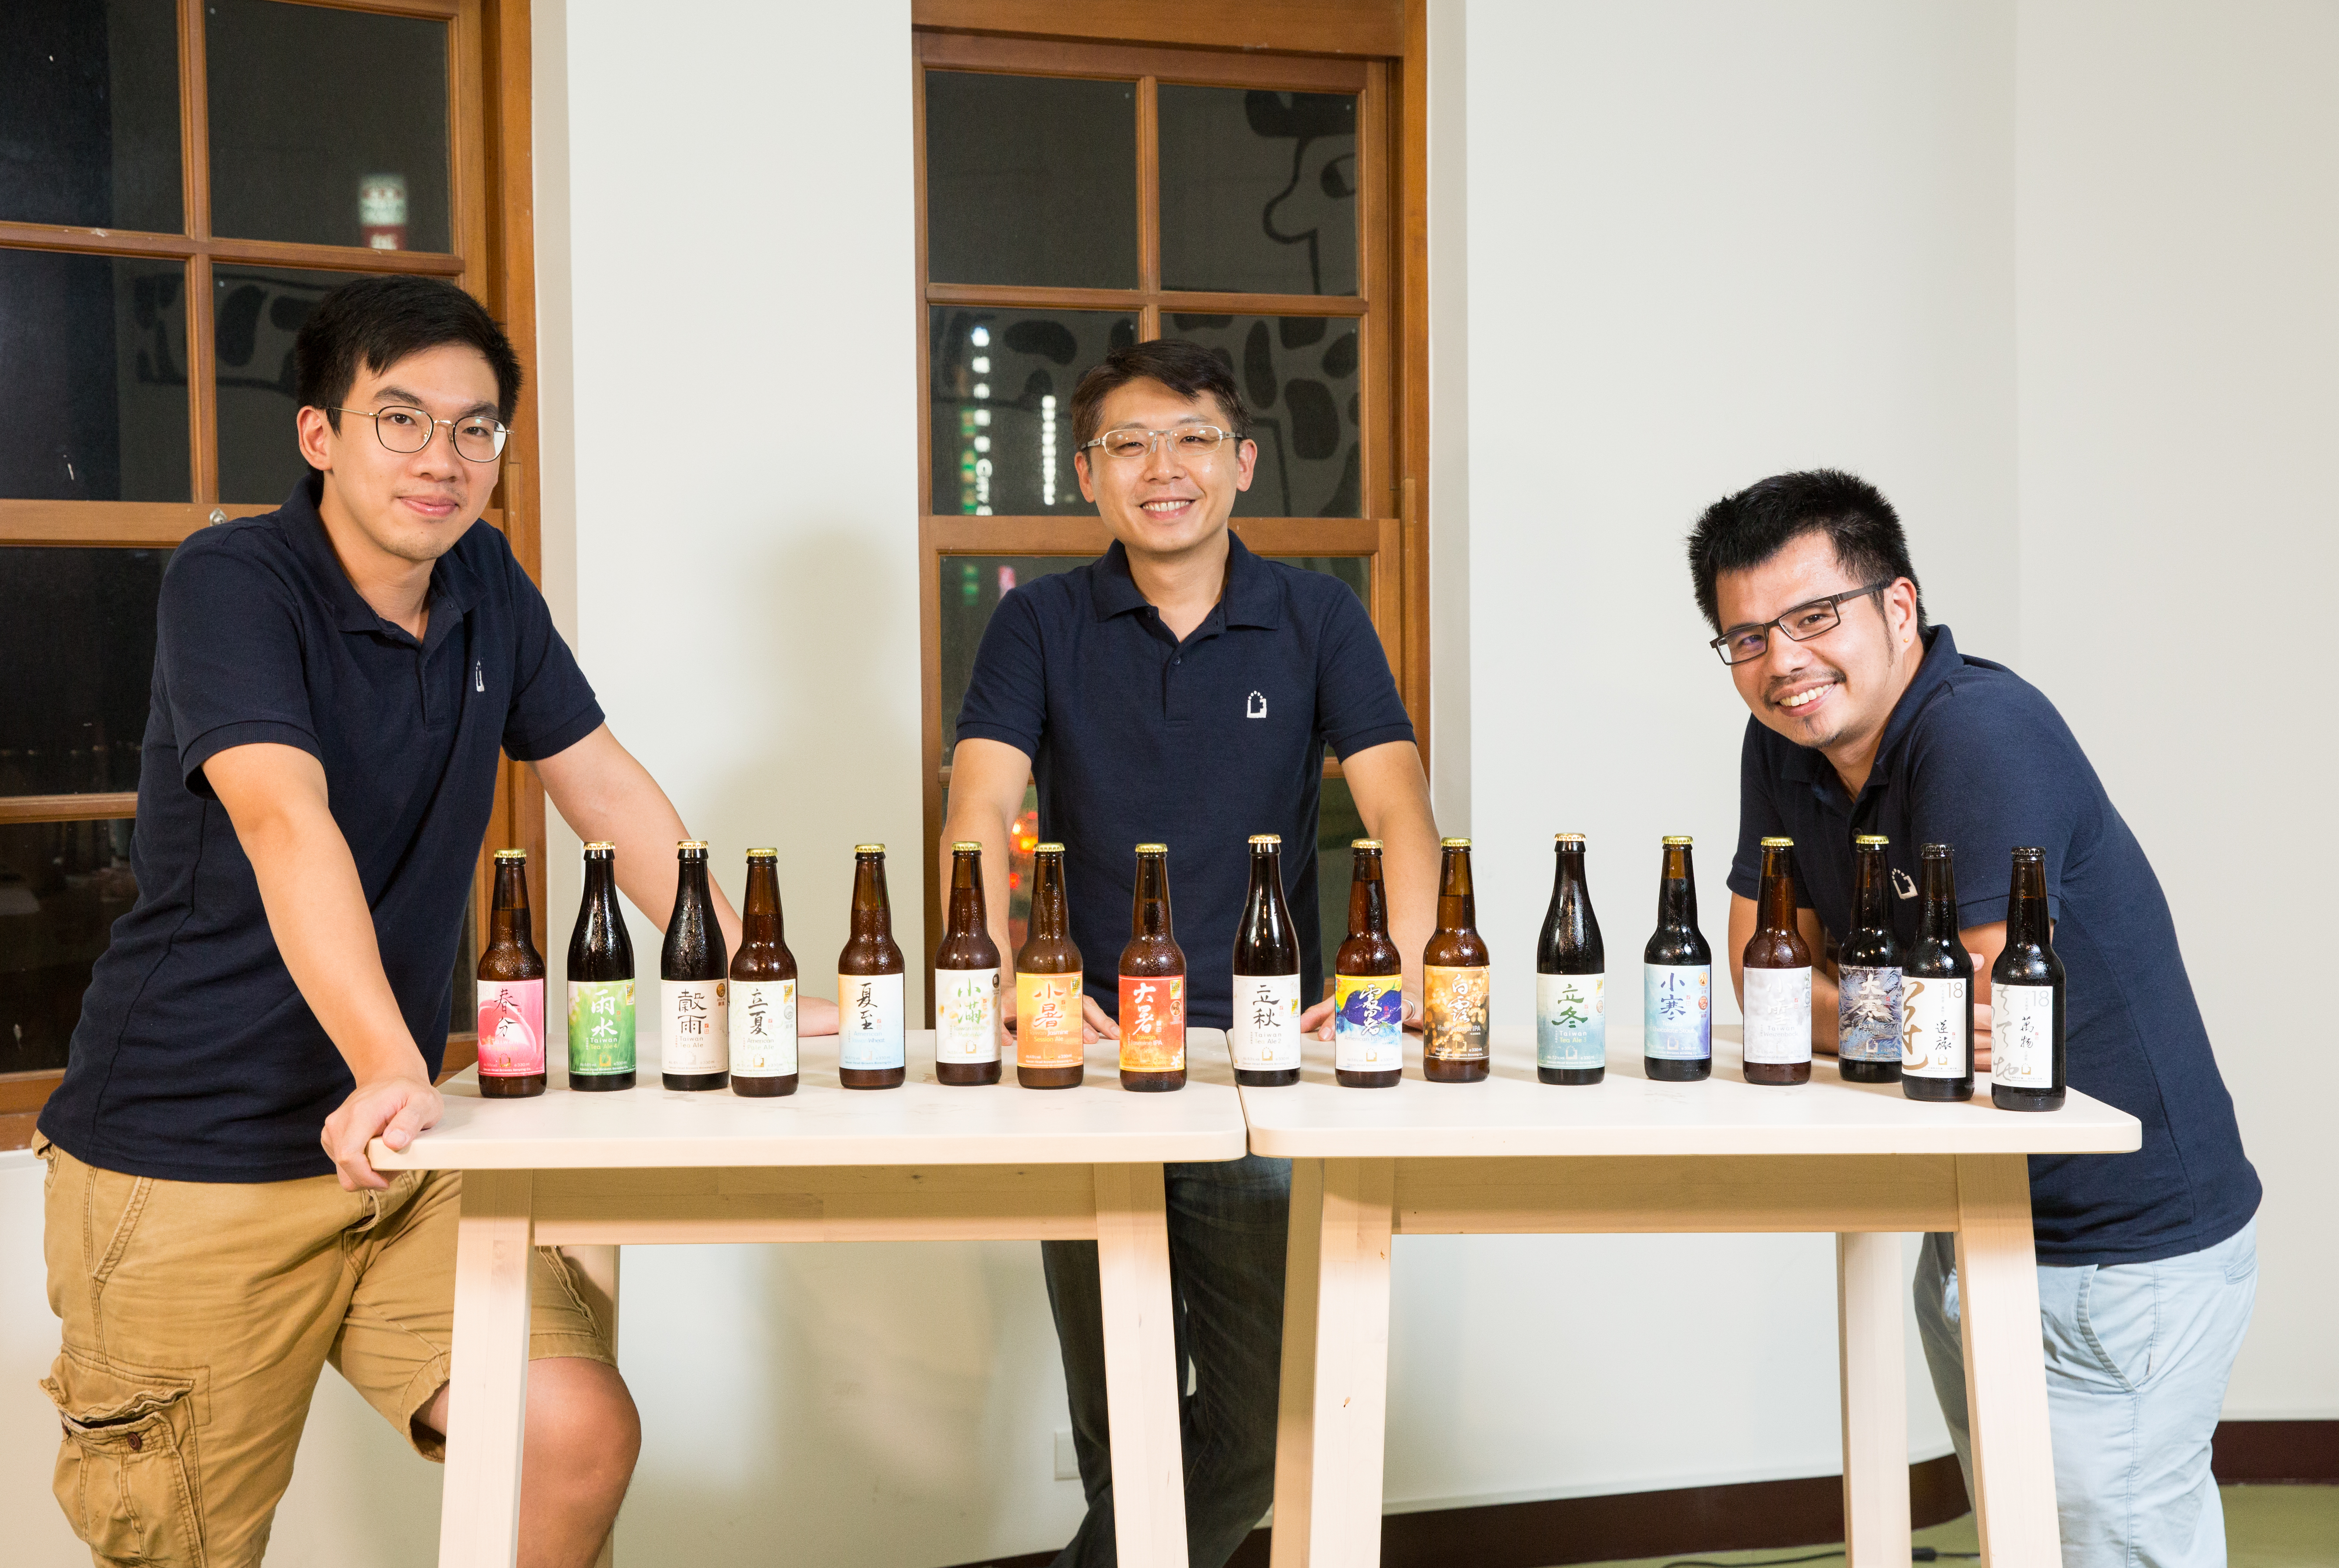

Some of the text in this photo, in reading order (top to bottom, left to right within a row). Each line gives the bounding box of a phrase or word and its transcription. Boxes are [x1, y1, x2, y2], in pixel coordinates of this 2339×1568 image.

[478, 984, 490, 997] 018
[493, 988, 519, 1037] 春分
[591, 989, 618, 1037] 雨水
[678, 989, 707, 1034] 穀雨
[748, 988, 768, 1036] 立夏
[857, 982, 878, 1030] 夏至
[958, 978, 981, 1024] 小滿
[1033, 983, 1065, 1028] 小暑
[1132, 982, 1156, 1036] 大暑
[1253, 985, 1281, 1029] 立秋
[1447, 973, 1470, 1023] 白露
[1552, 984, 1588, 1028] 立冬
[1659, 972, 1686, 1021] 小寒
[1767, 976, 1793, 1025] 小雪
[1856, 974, 1887, 1023] 大寒
[1935, 1020, 1951, 1050] 逆旅
[2020, 1016, 2034, 1048] 萬物
